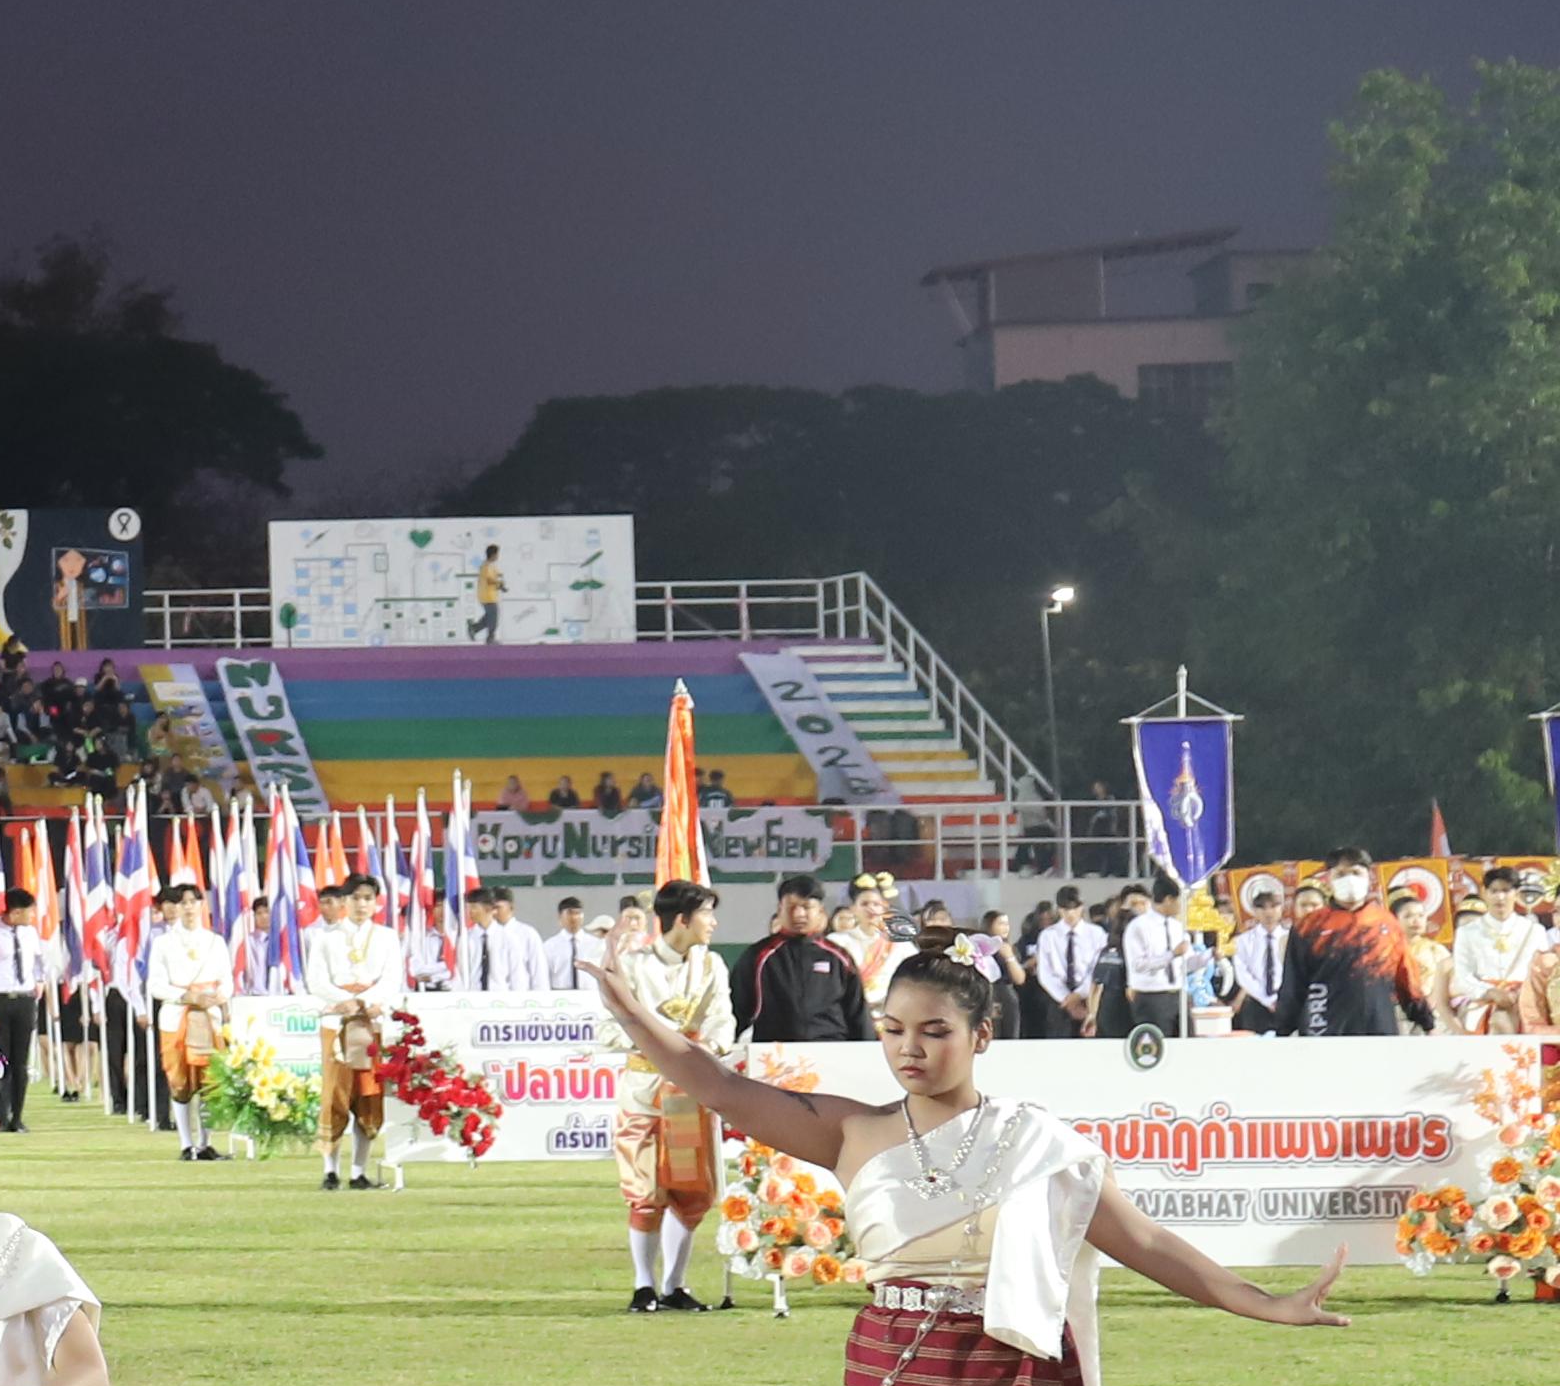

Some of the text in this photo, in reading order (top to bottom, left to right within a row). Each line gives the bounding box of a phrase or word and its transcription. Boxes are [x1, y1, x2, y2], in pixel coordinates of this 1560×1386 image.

[479, 1016, 595, 1043] การแข่งขันกี
[490, 1055, 618, 1101] "ปลาบึก
[1074, 1104, 1448, 1172] าชภัฏกำแพงเพชร
[1130, 1190, 1413, 1219] AJABHAT UNIVERSITY
